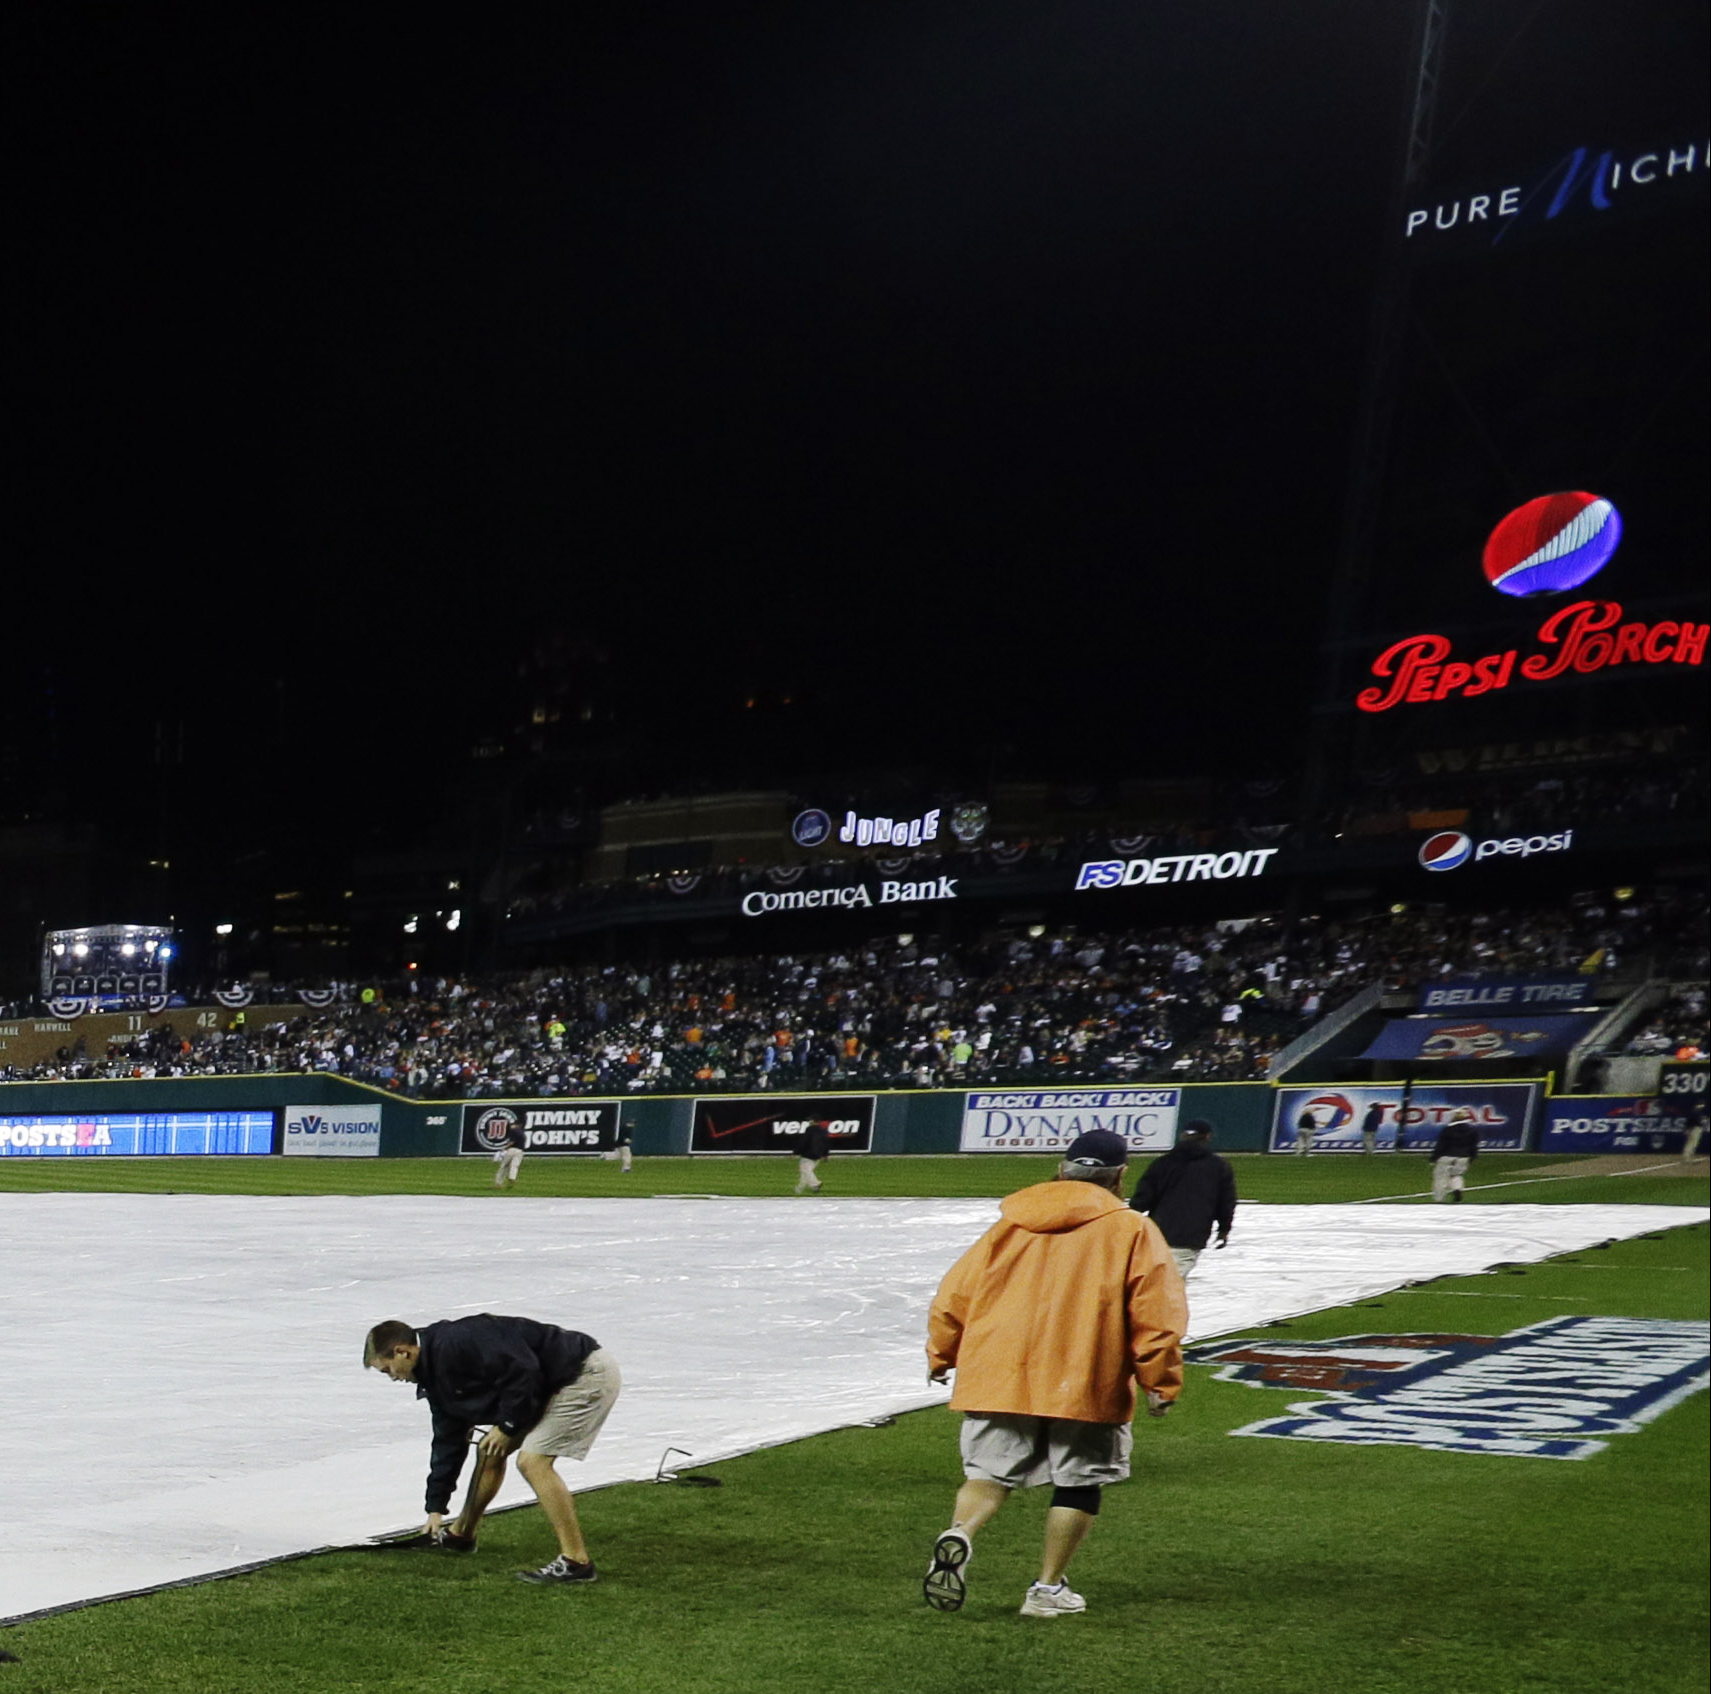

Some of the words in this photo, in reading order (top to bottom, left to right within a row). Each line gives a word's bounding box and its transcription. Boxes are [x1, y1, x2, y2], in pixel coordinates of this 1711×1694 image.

[1405, 188, 1521, 236] PURE
[1356, 633, 1518, 714] PEPSI
[1521, 599, 1710, 682] PORCH
[839, 808, 941, 848] JUNGLE
[1475, 830, 1574, 862] pepsi
[879, 874, 960, 904] Bank
[1427, 986, 1516, 1007] BELLE
[1521, 982, 1590, 1002] TIRE
[127, 1016, 142, 1031] 11
[196, 1012, 217, 1028] 42
[975, 1094, 1036, 1108] BACK!
[1039, 1093, 1102, 1107] BACK!
[1104, 1092, 1172, 1107] BACK!
[332, 1121, 379, 1134] VISION
[525, 1110, 602, 1129] JIMMY
[772, 1118, 860, 1137] veron
[981, 1110, 1159, 1138] DYNAMIC
[524, 1130, 600, 1149] JOHN'S
